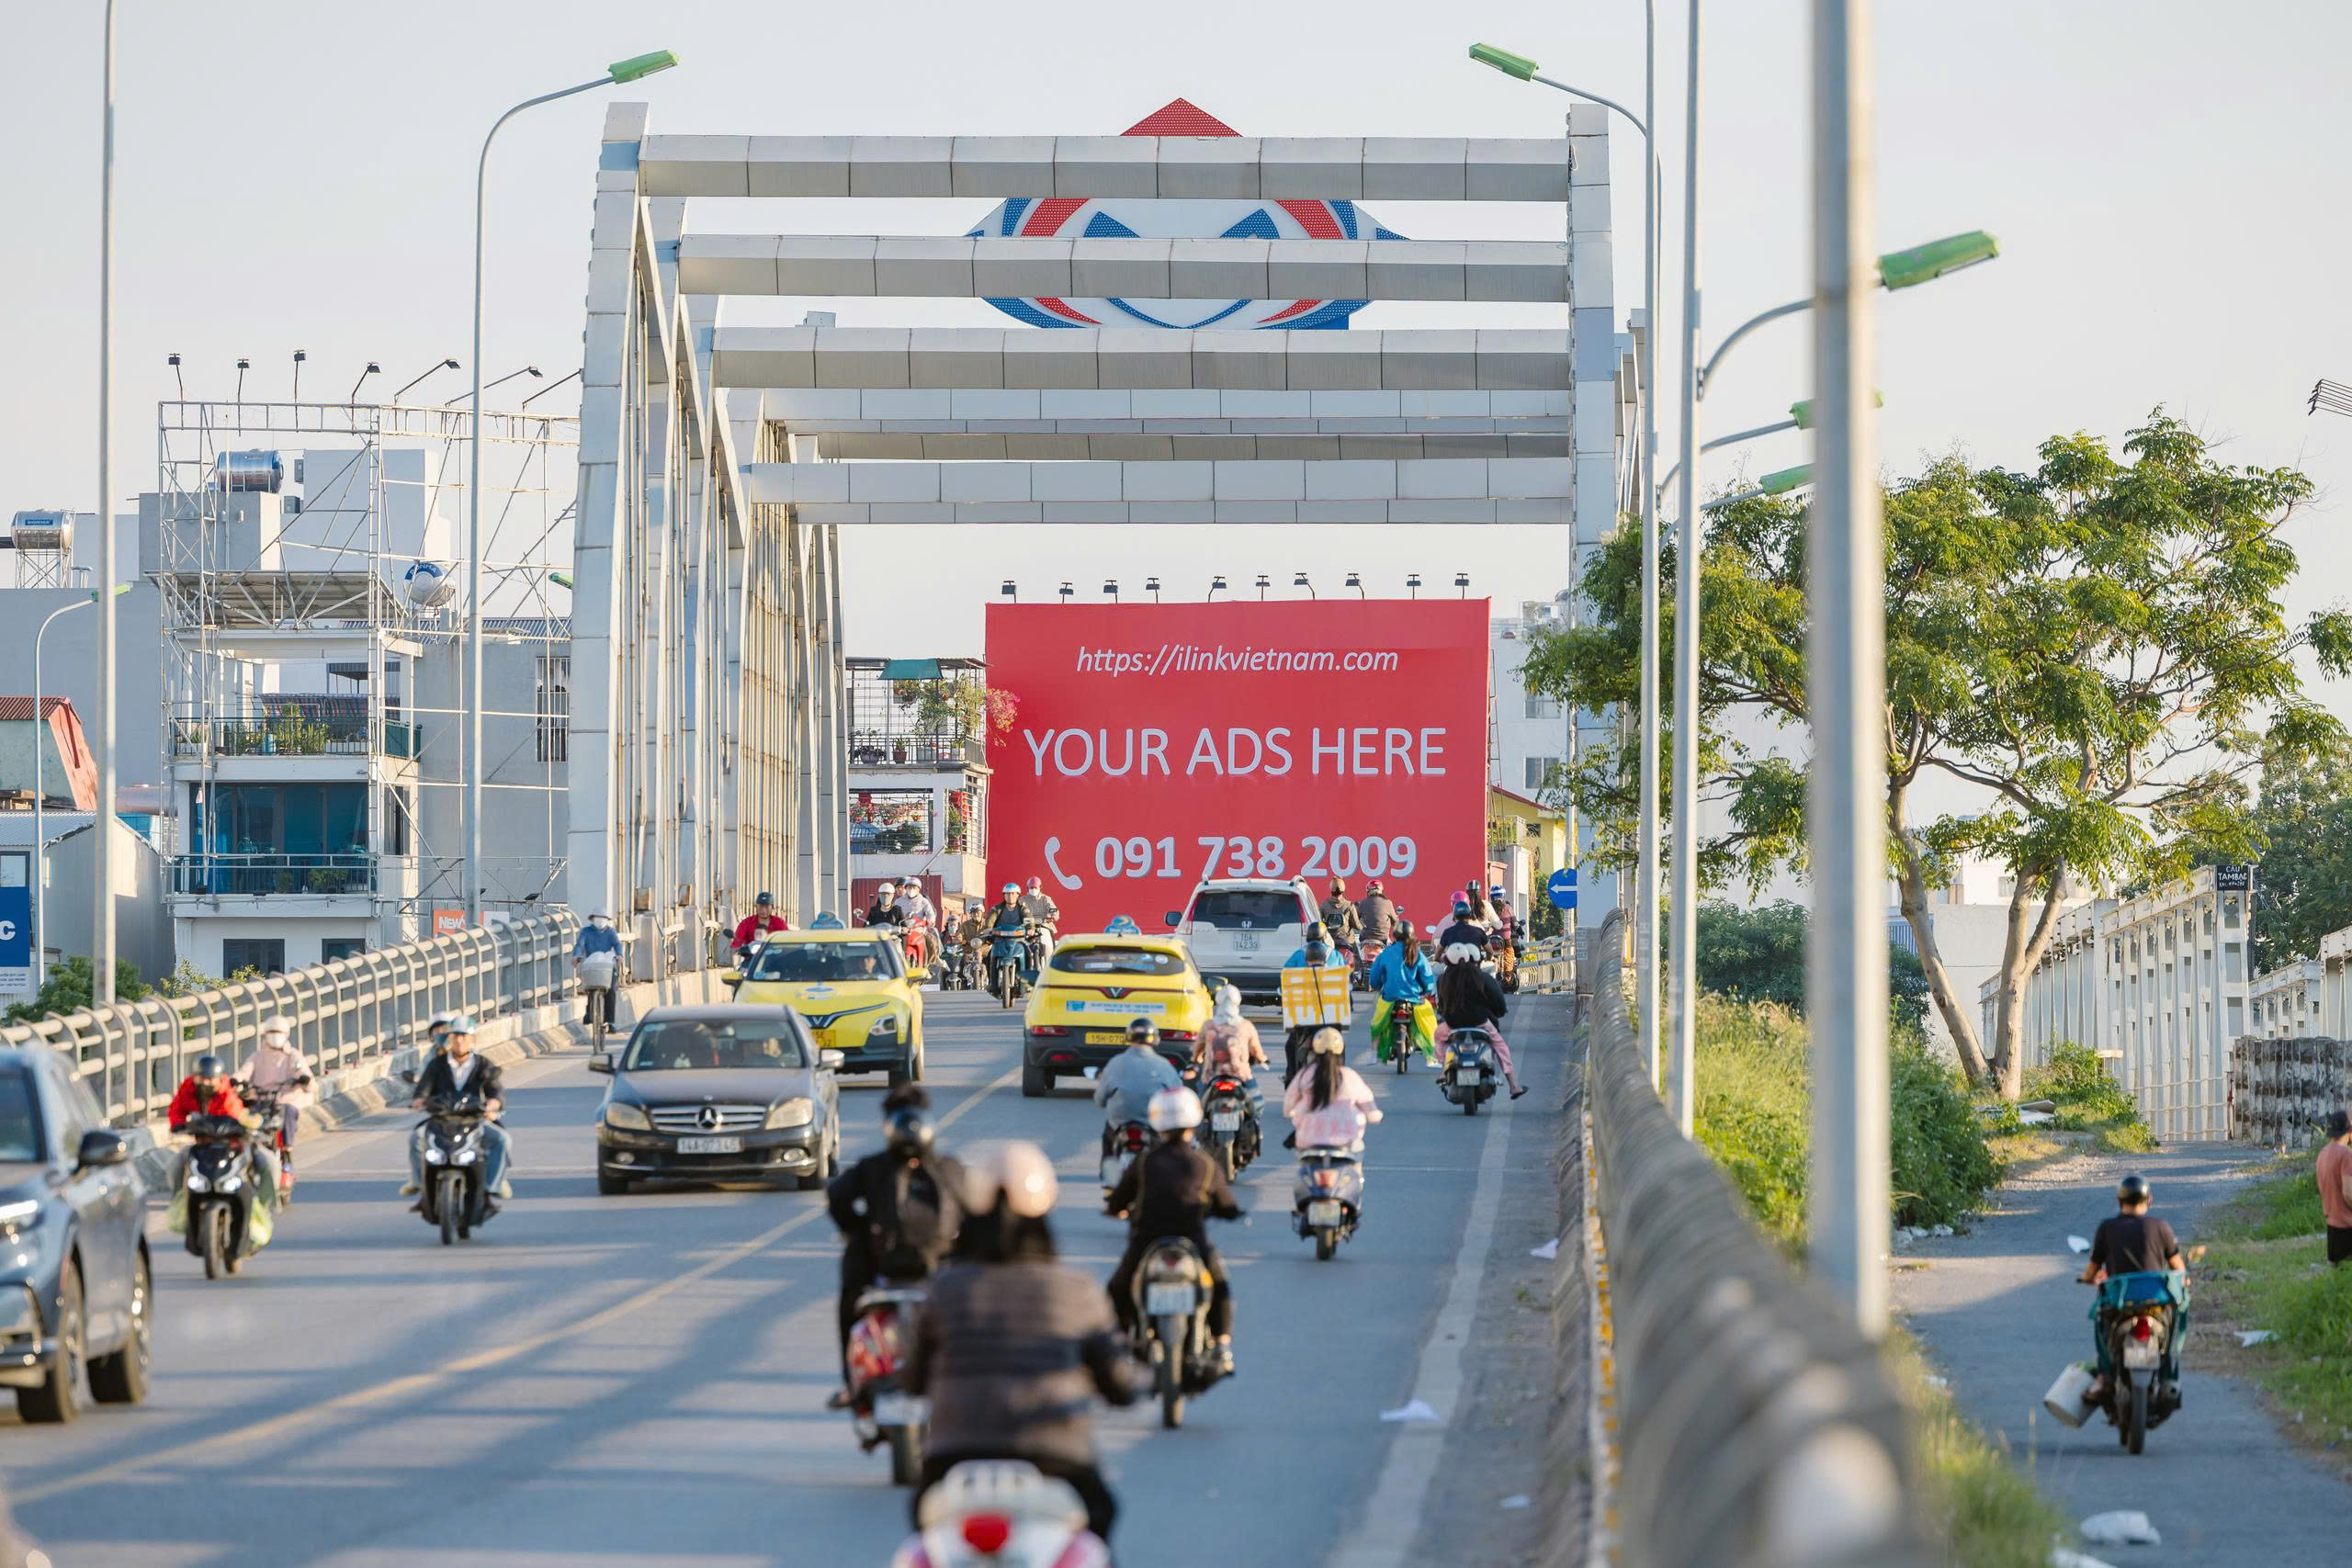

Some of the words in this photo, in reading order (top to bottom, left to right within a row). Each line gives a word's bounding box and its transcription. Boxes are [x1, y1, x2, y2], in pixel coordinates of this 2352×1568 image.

[1077, 644, 1398, 678] https://ilinkvietnam.com
[1023, 728, 1171, 776] YOUR
[1185, 727, 1293, 775] ADS
[1312, 727, 1447, 775] HERE
[1095, 836, 1182, 879] 091
[1197, 836, 1285, 879] 738
[1292, 836, 1417, 879] 2009
